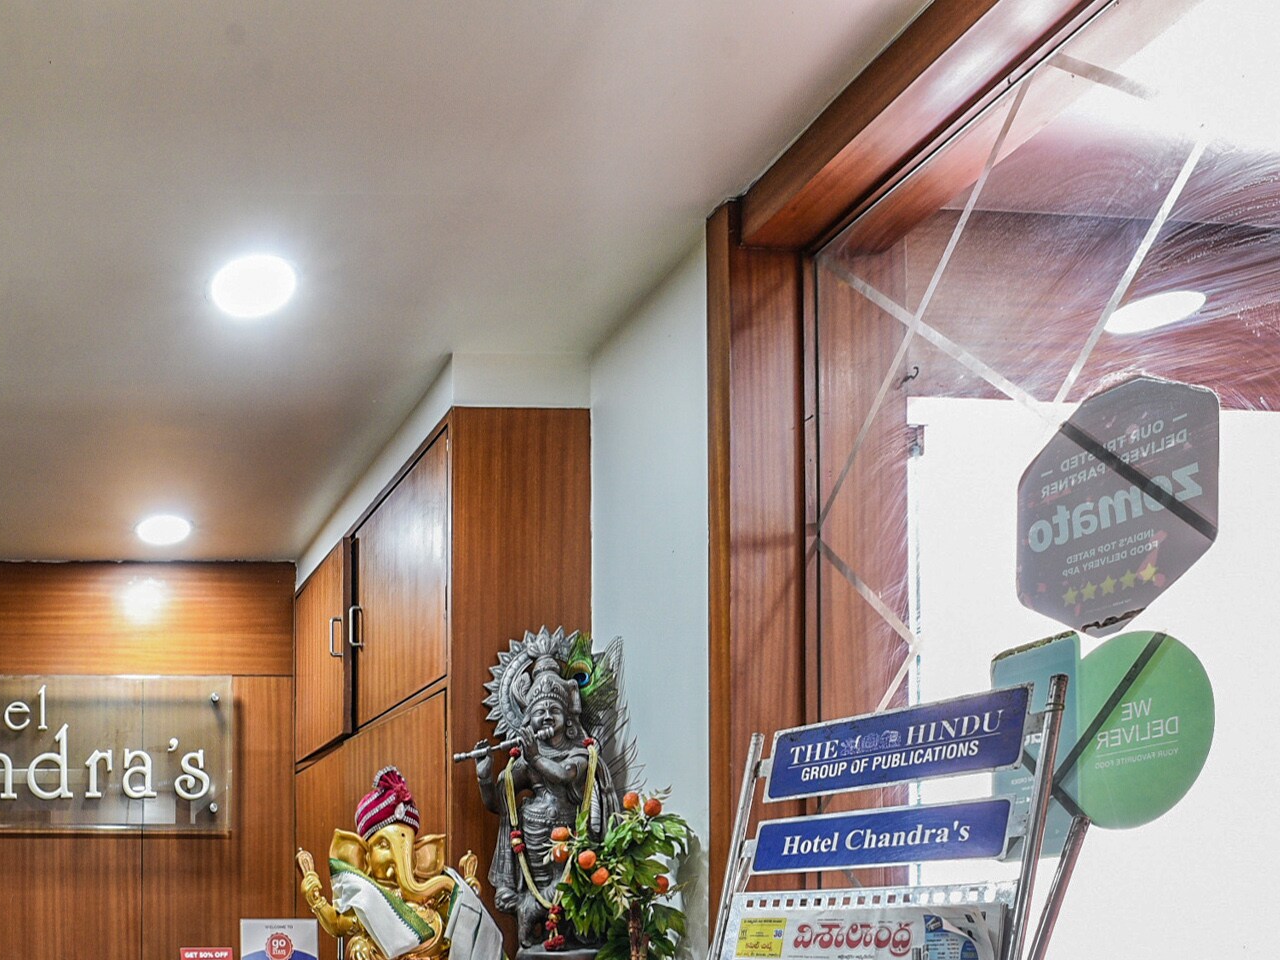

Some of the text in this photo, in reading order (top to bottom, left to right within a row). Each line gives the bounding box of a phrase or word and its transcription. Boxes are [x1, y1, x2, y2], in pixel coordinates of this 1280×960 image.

[789, 739, 839, 765] THE
[905, 709, 1005, 747] HINDU
[801, 740, 979, 782] GROUP OF PUBLICATIONS
[781, 820, 970, 855] Hotel Chandra's
[272, 939, 286, 949] go
